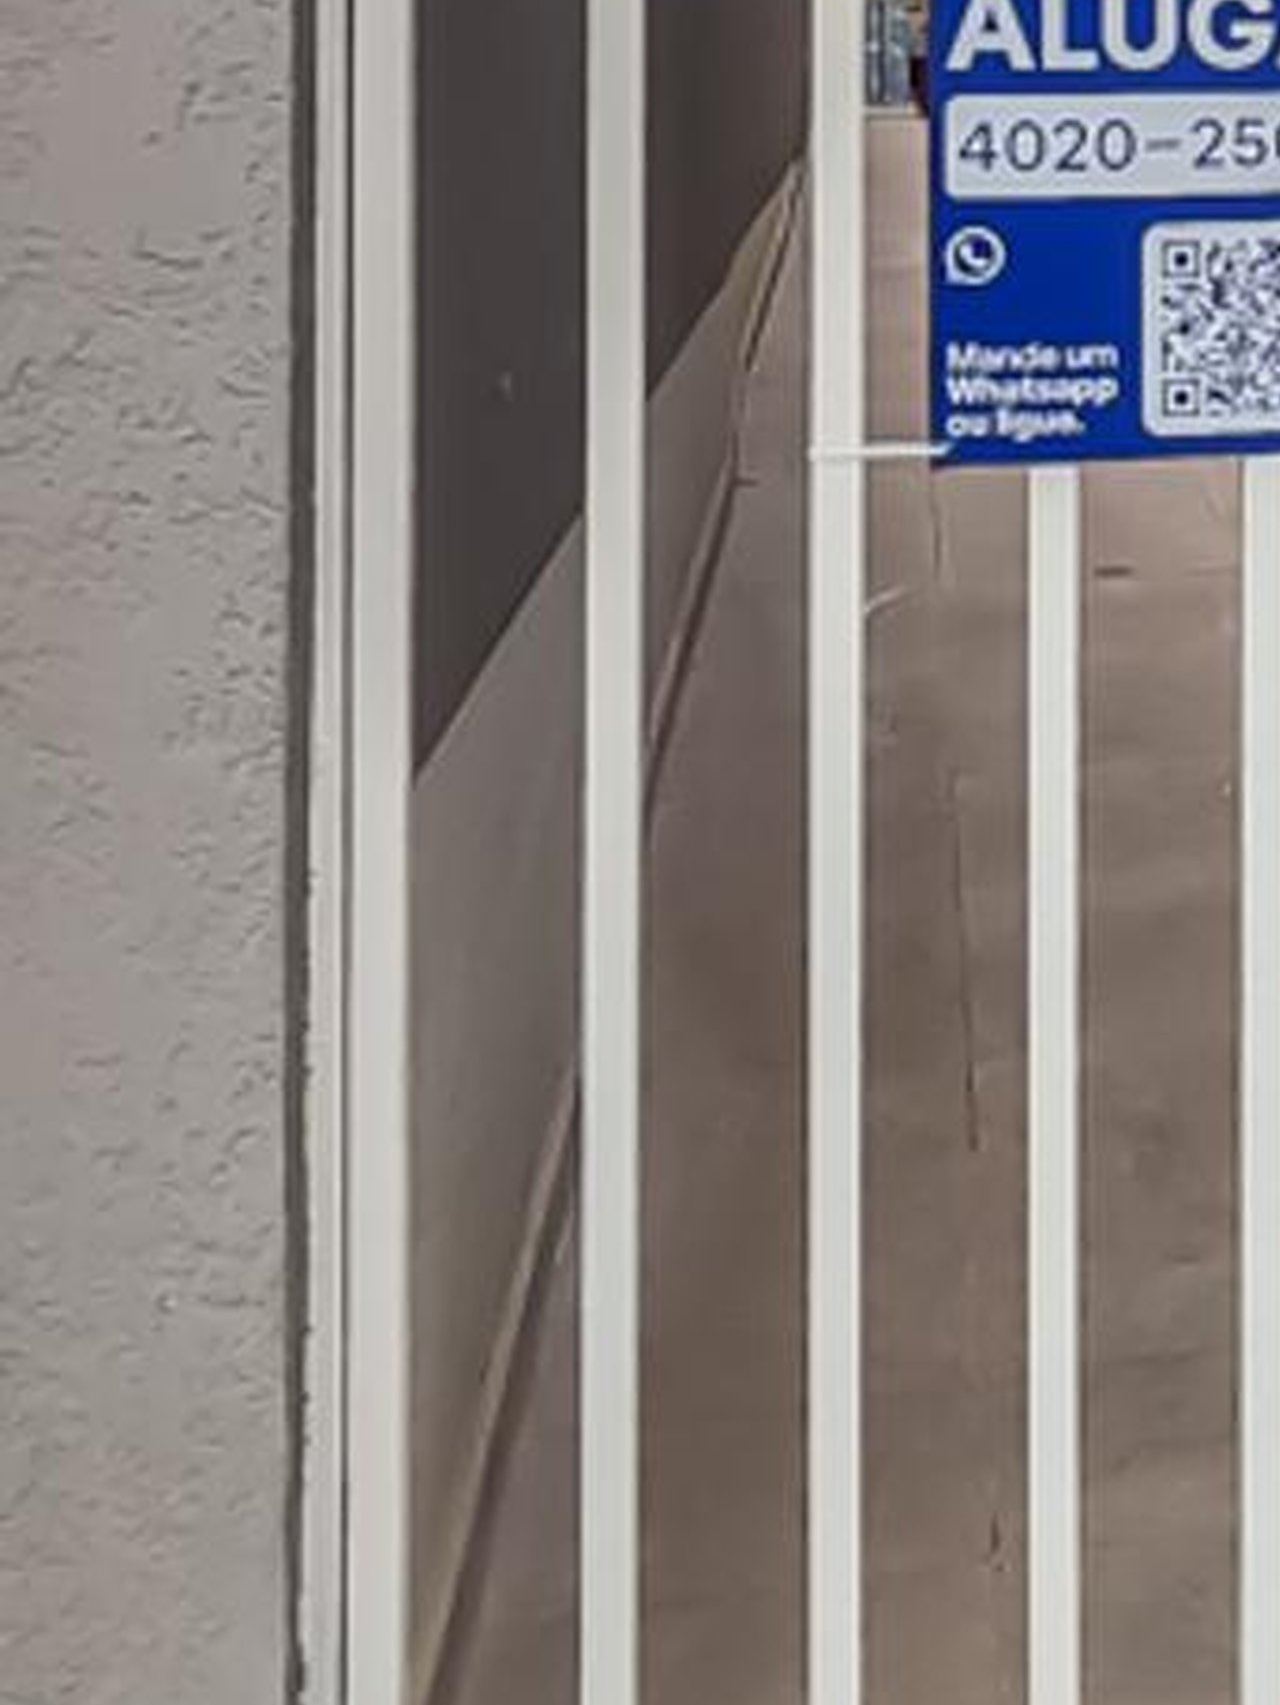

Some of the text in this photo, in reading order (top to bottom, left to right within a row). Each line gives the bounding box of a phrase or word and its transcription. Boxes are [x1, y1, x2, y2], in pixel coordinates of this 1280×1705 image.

[946, 341, 1118, 372] Mande um
[946, 376, 1119, 407] Whatsapp
[946, 413, 989, 438] ou
